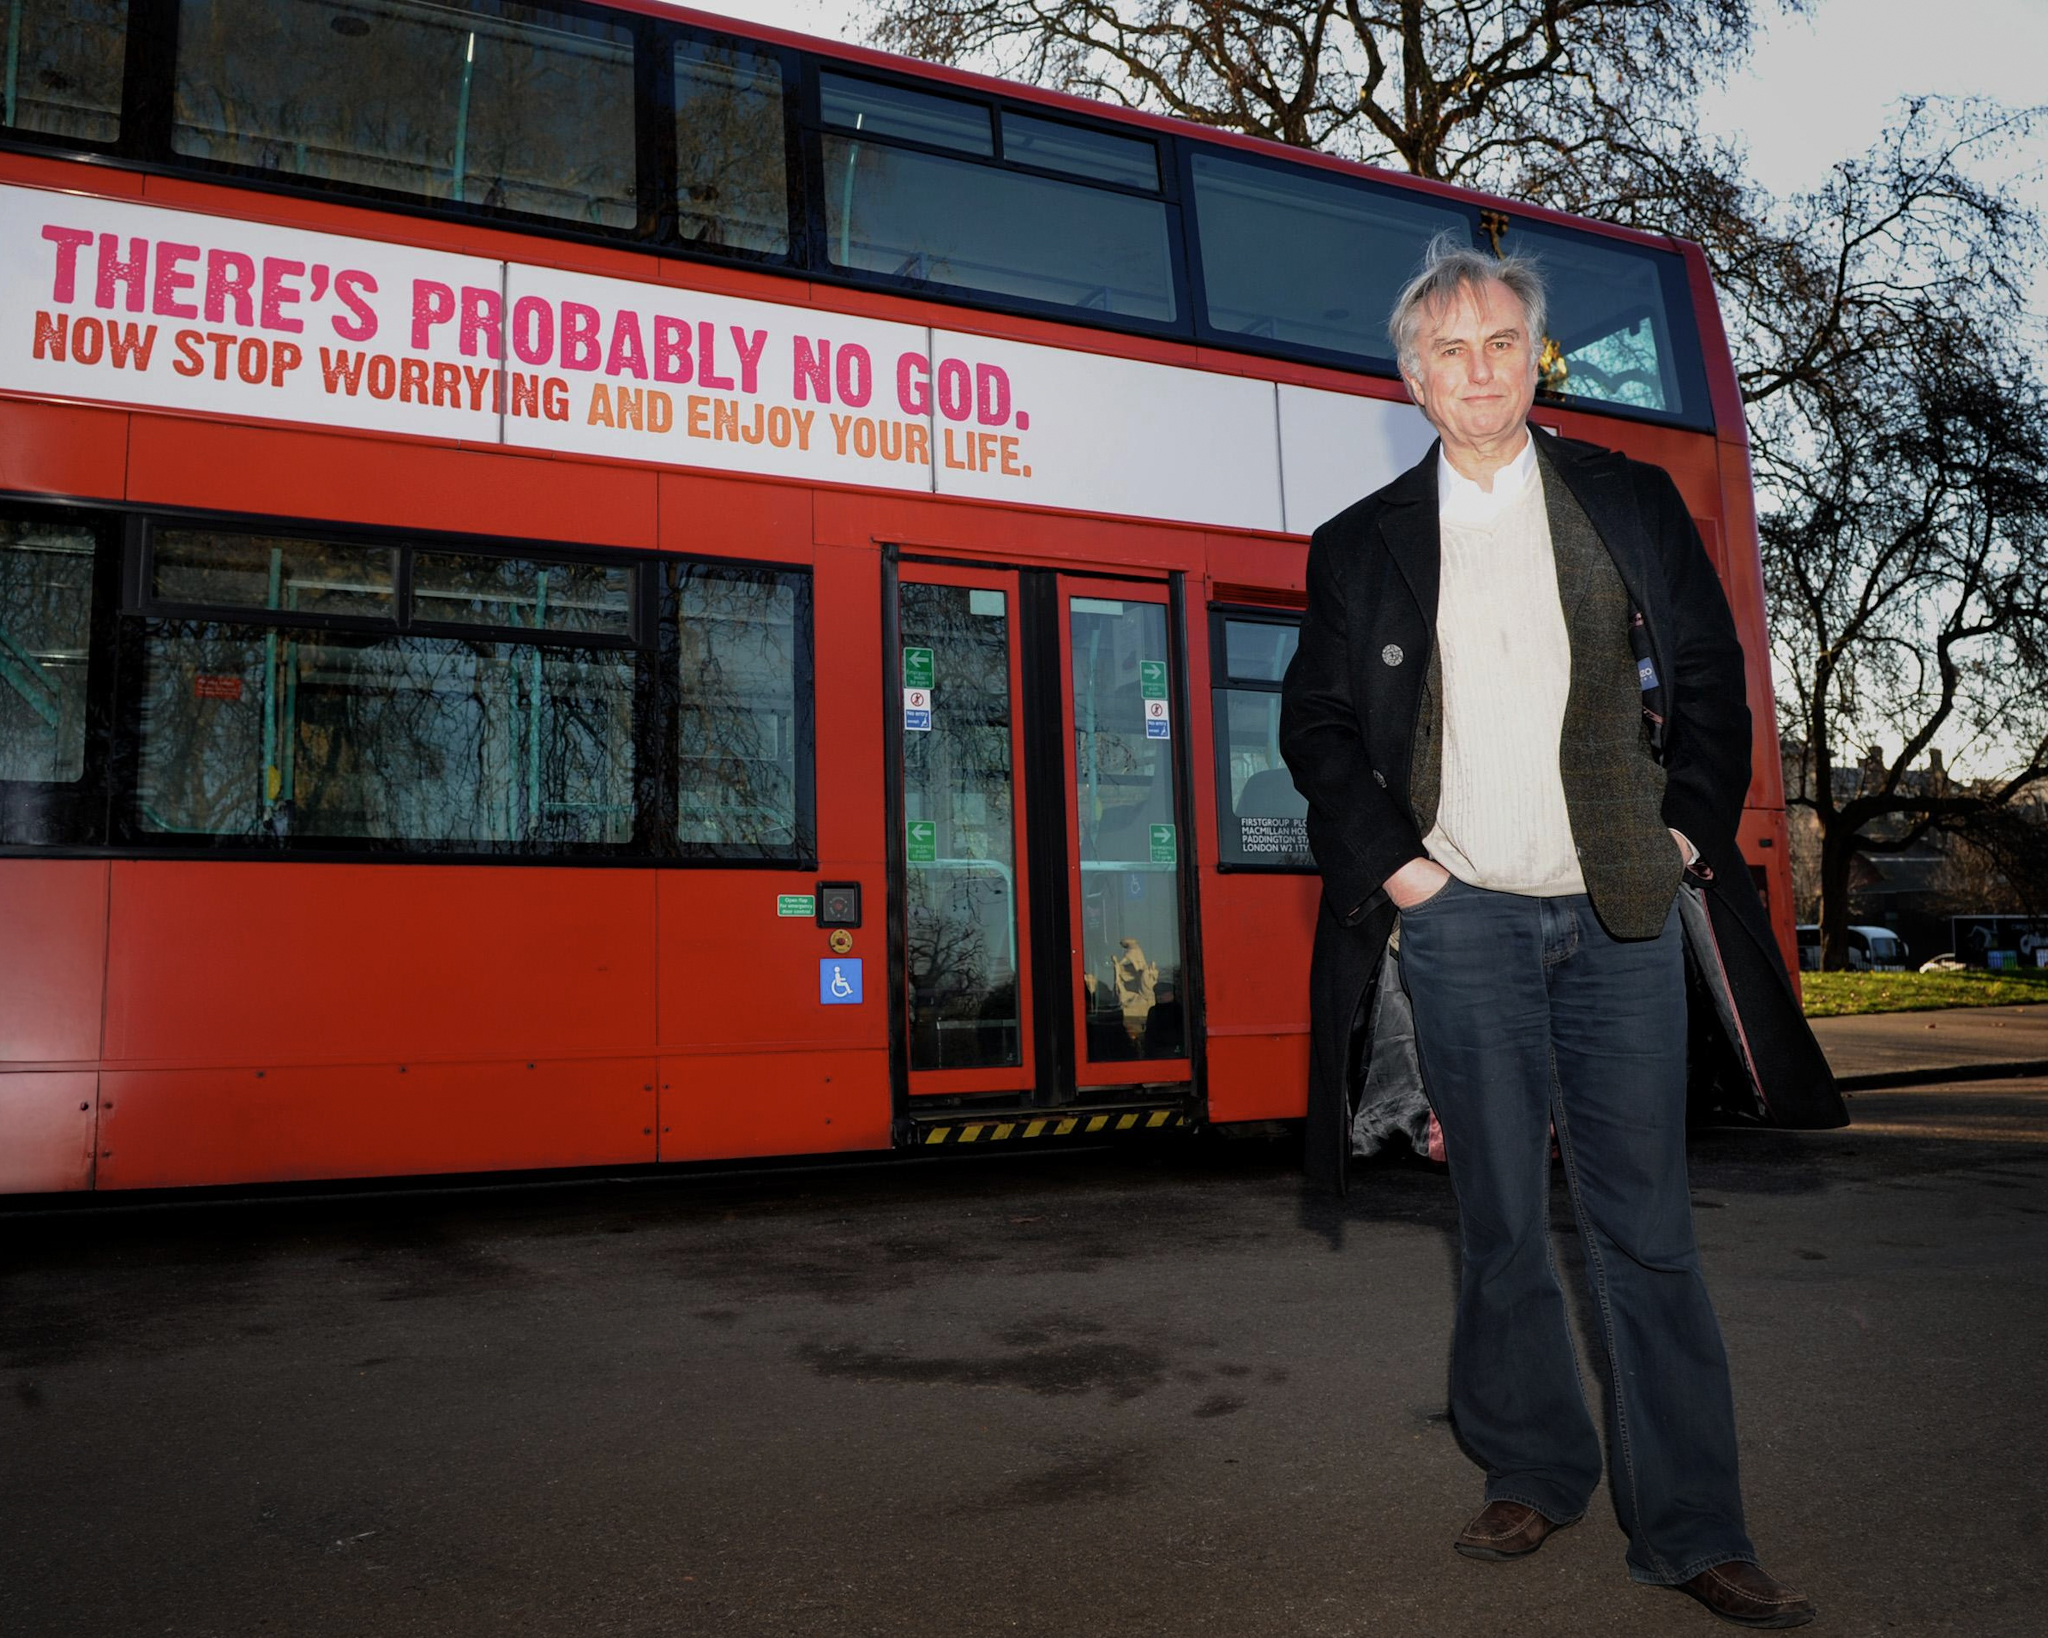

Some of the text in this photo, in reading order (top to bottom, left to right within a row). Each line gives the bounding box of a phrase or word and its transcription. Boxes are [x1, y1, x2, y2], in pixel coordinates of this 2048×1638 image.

[41, 224, 1030, 431] THERE'S PROBABLY NO GOD.
[33, 310, 1032, 478] NOW STOP WORRYING AND ENJOY YOUR LIFE.
[1241, 818, 1290, 826] FIRSTGROUP
[1242, 827, 1290, 835] MACMILLAN
[1242, 835, 1295, 843] PADDINGTON
[1243, 844, 1279, 852] LONDON
[1280, 844, 1293, 852] W2
